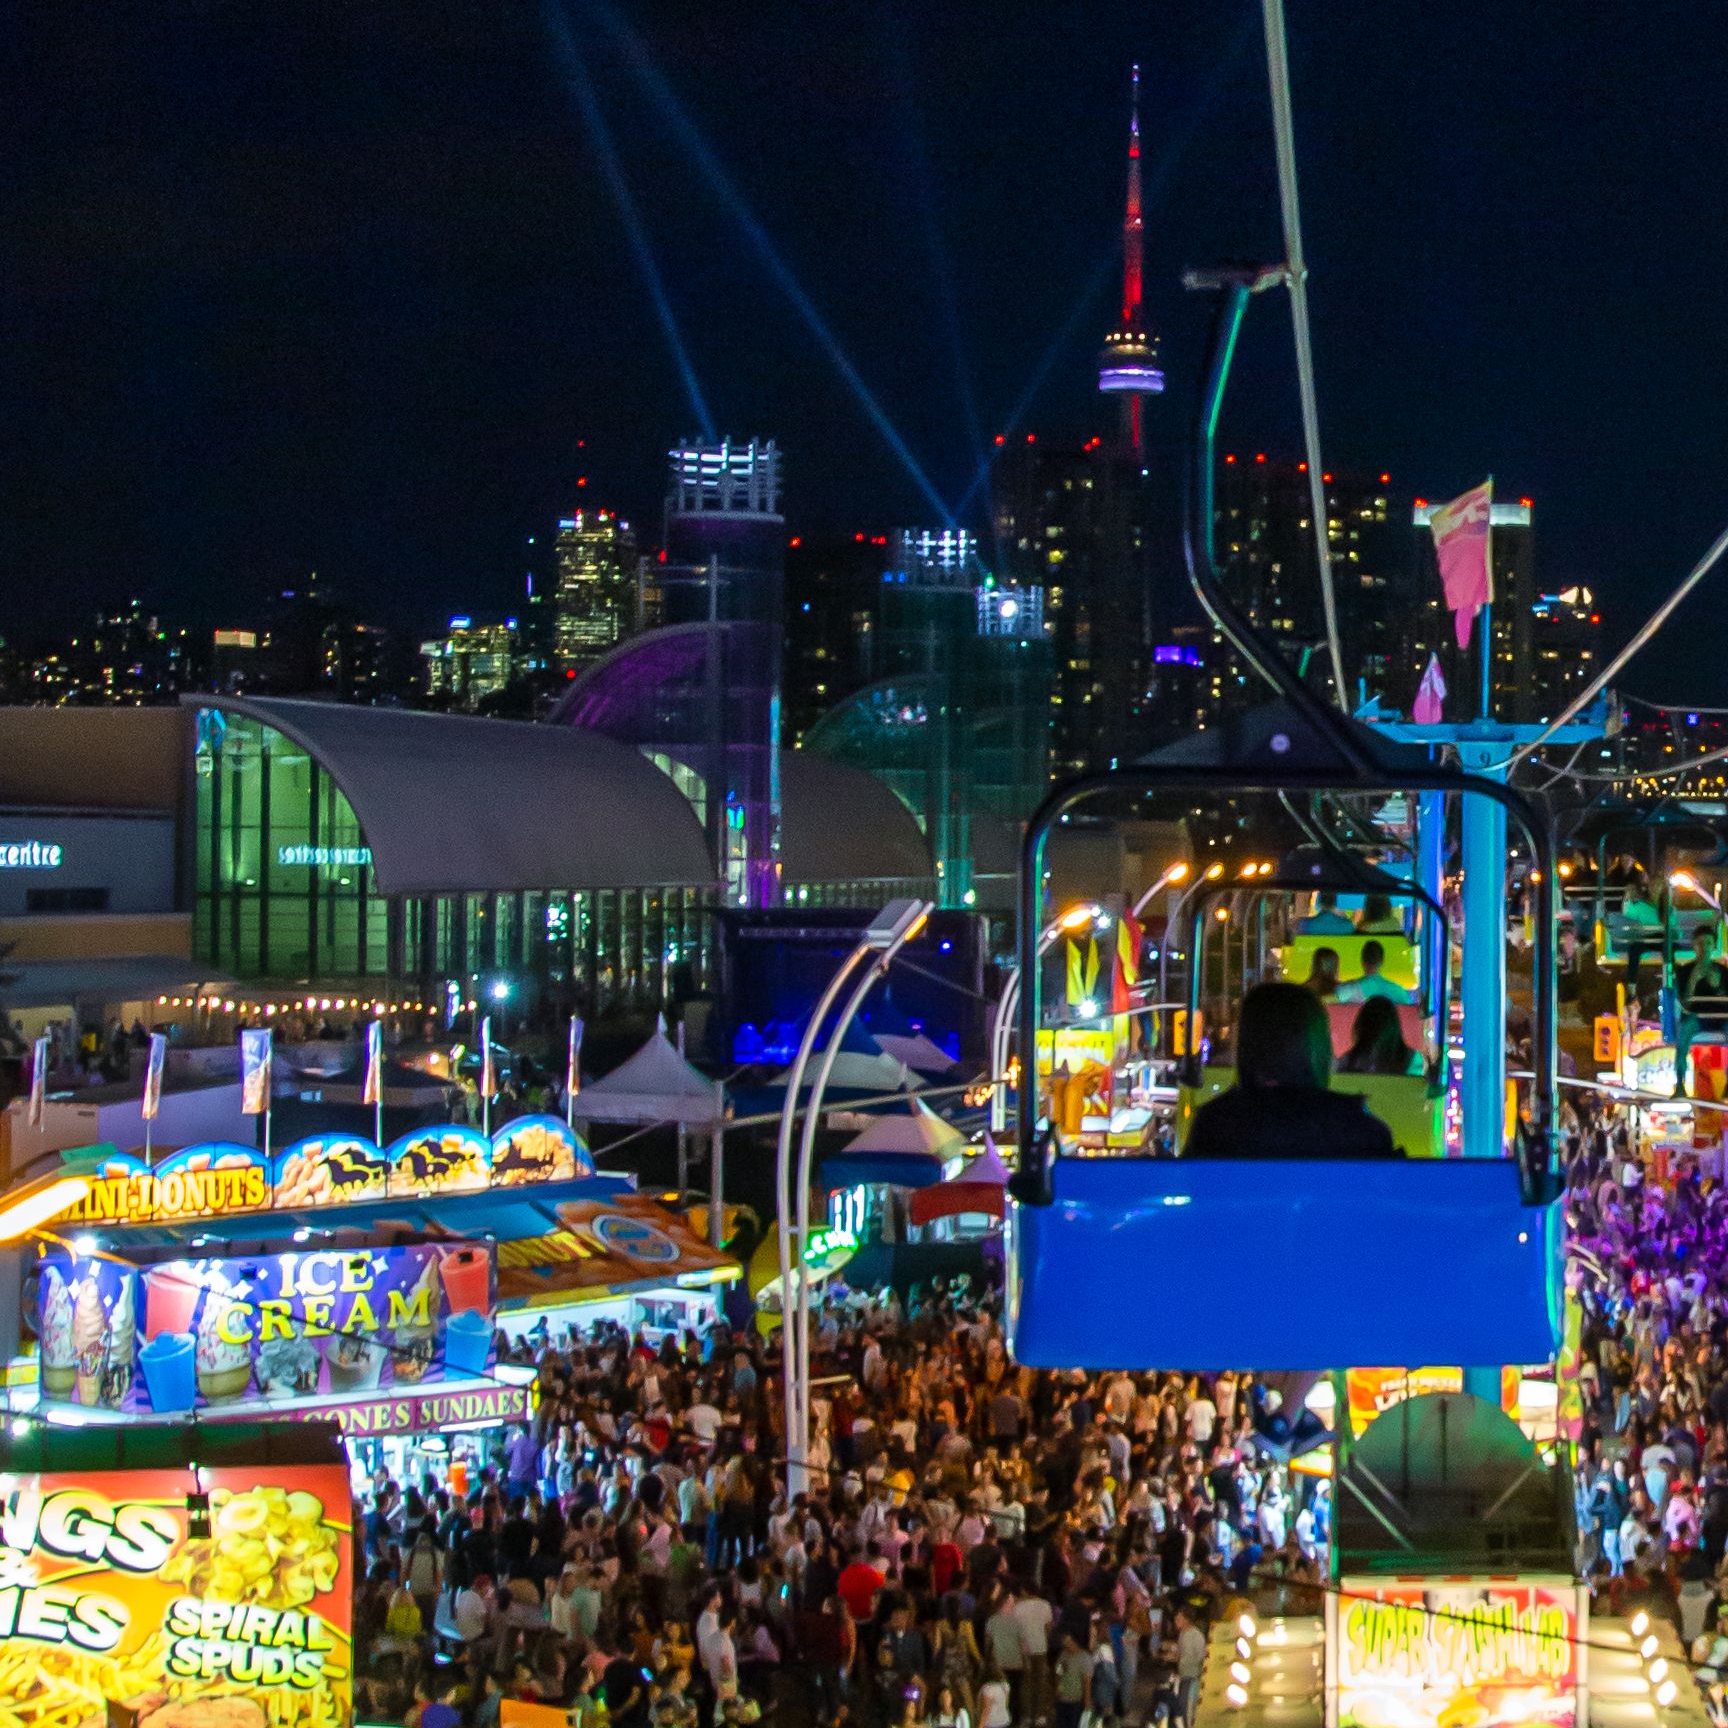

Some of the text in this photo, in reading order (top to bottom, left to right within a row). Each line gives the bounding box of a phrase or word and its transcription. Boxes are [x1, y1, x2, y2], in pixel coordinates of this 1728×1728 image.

[278, 1251, 374, 1297] ICE
[216, 1288, 432, 1344] CREAM
[420, 1389, 525, 1425] SUNDAES
[169, 1599, 333, 1650] SPIRAL
[1347, 1599, 1428, 1676] SUPER
[169, 1639, 324, 1688] SPUDS
